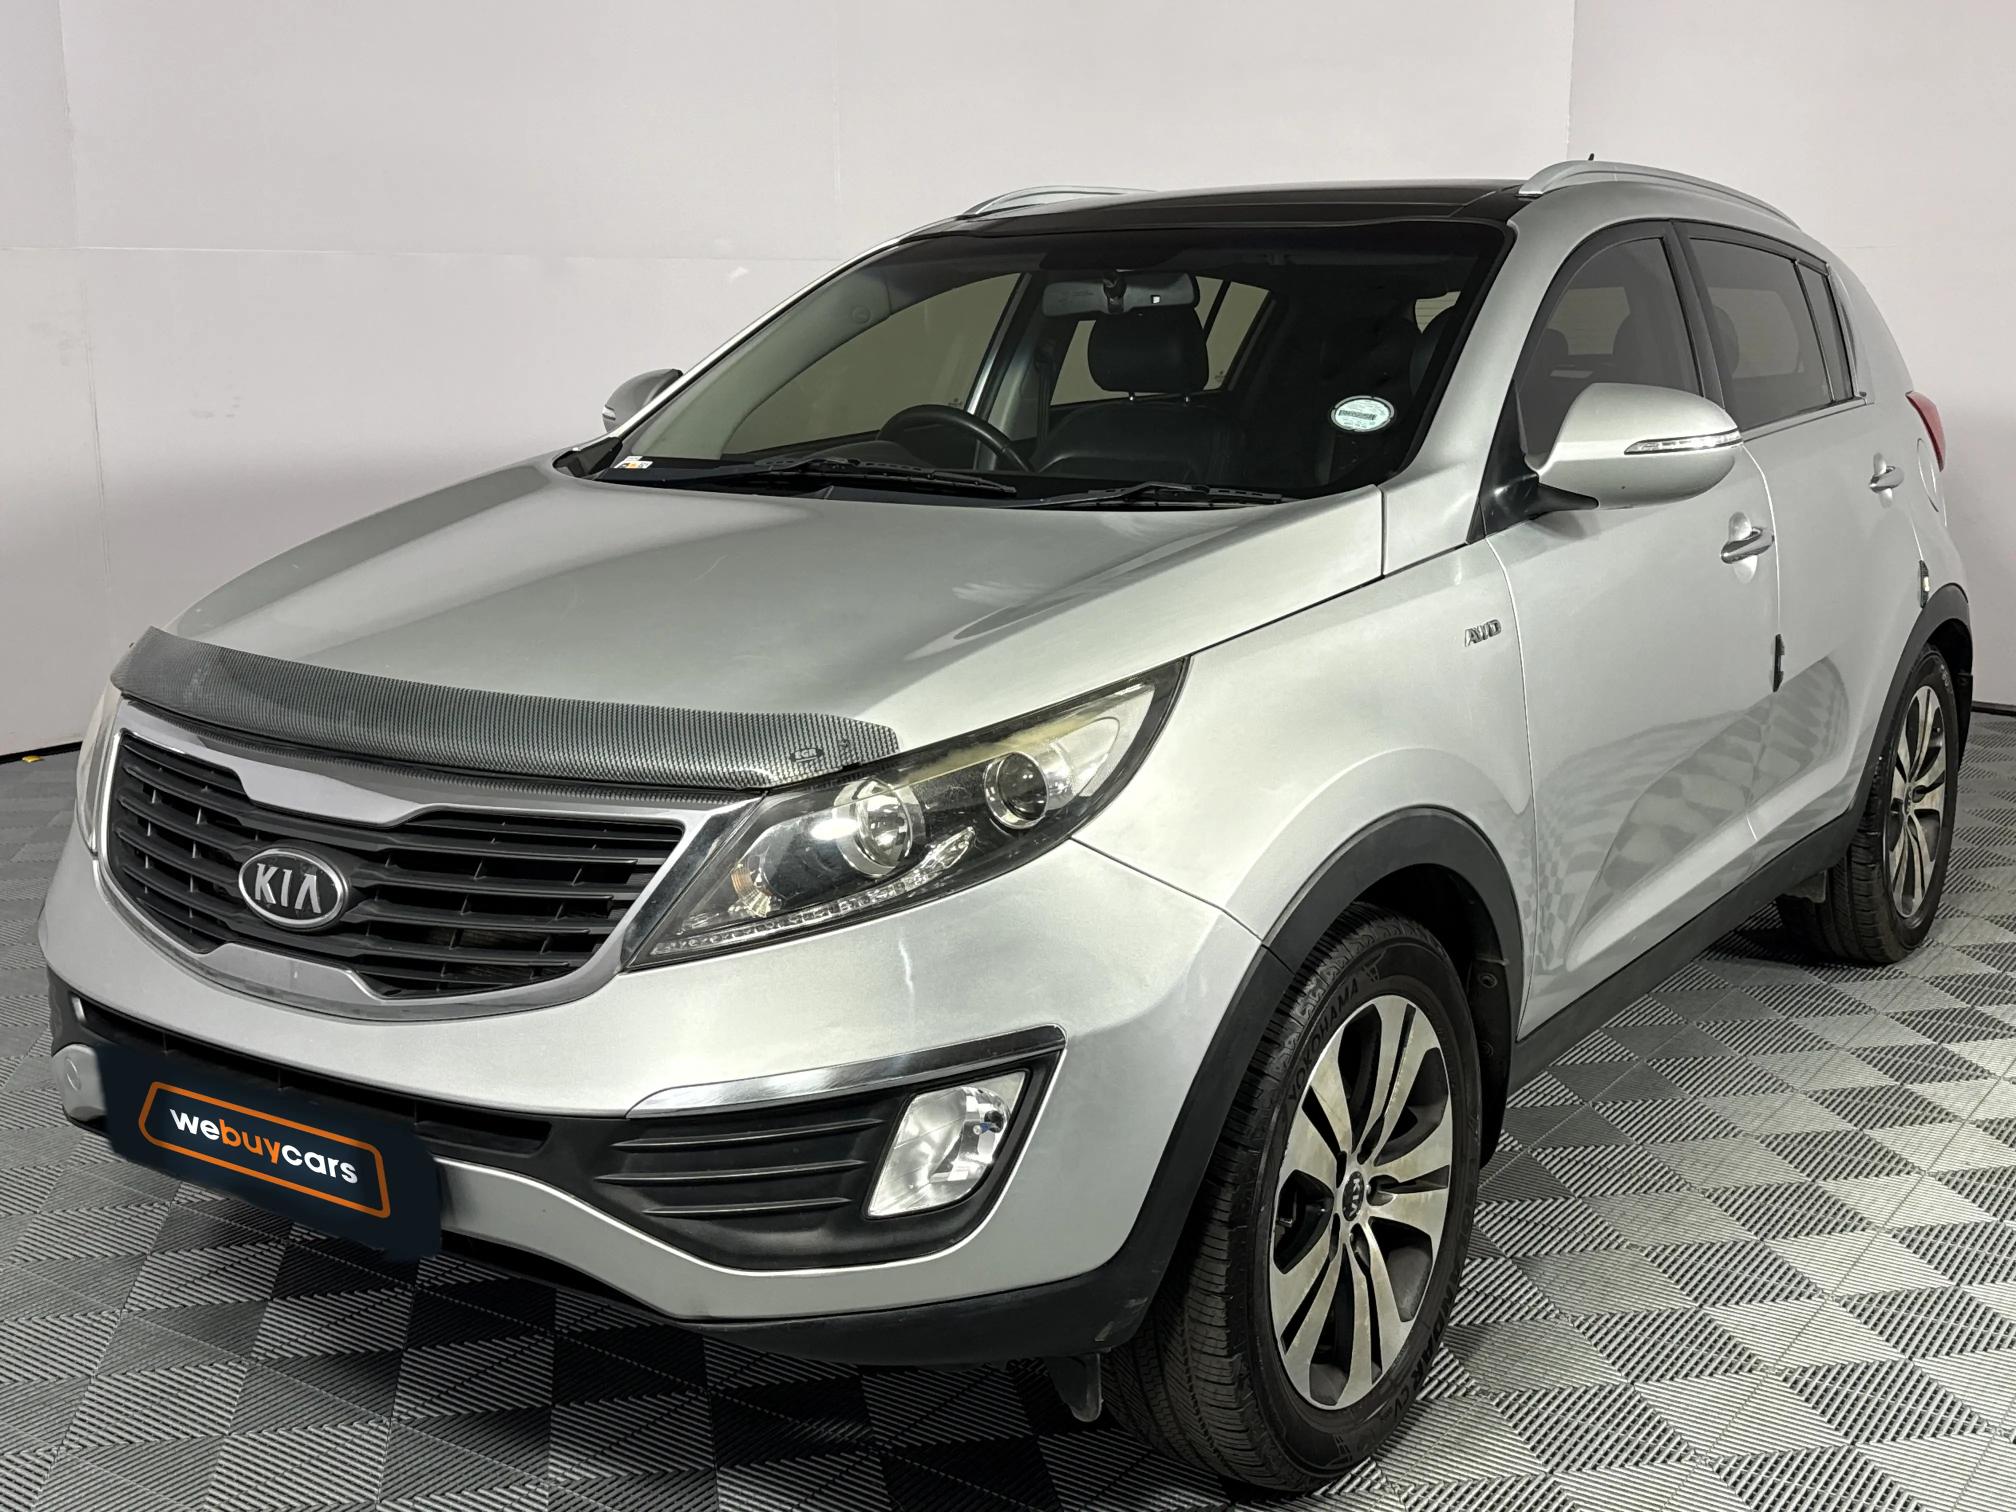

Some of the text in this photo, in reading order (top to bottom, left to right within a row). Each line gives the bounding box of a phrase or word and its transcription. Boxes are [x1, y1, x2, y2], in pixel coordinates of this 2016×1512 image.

[1464, 619, 1501, 647] AWD
[254, 862, 322, 914] KIA
[1288, 977, 1359, 1100] YOKOHAMA
